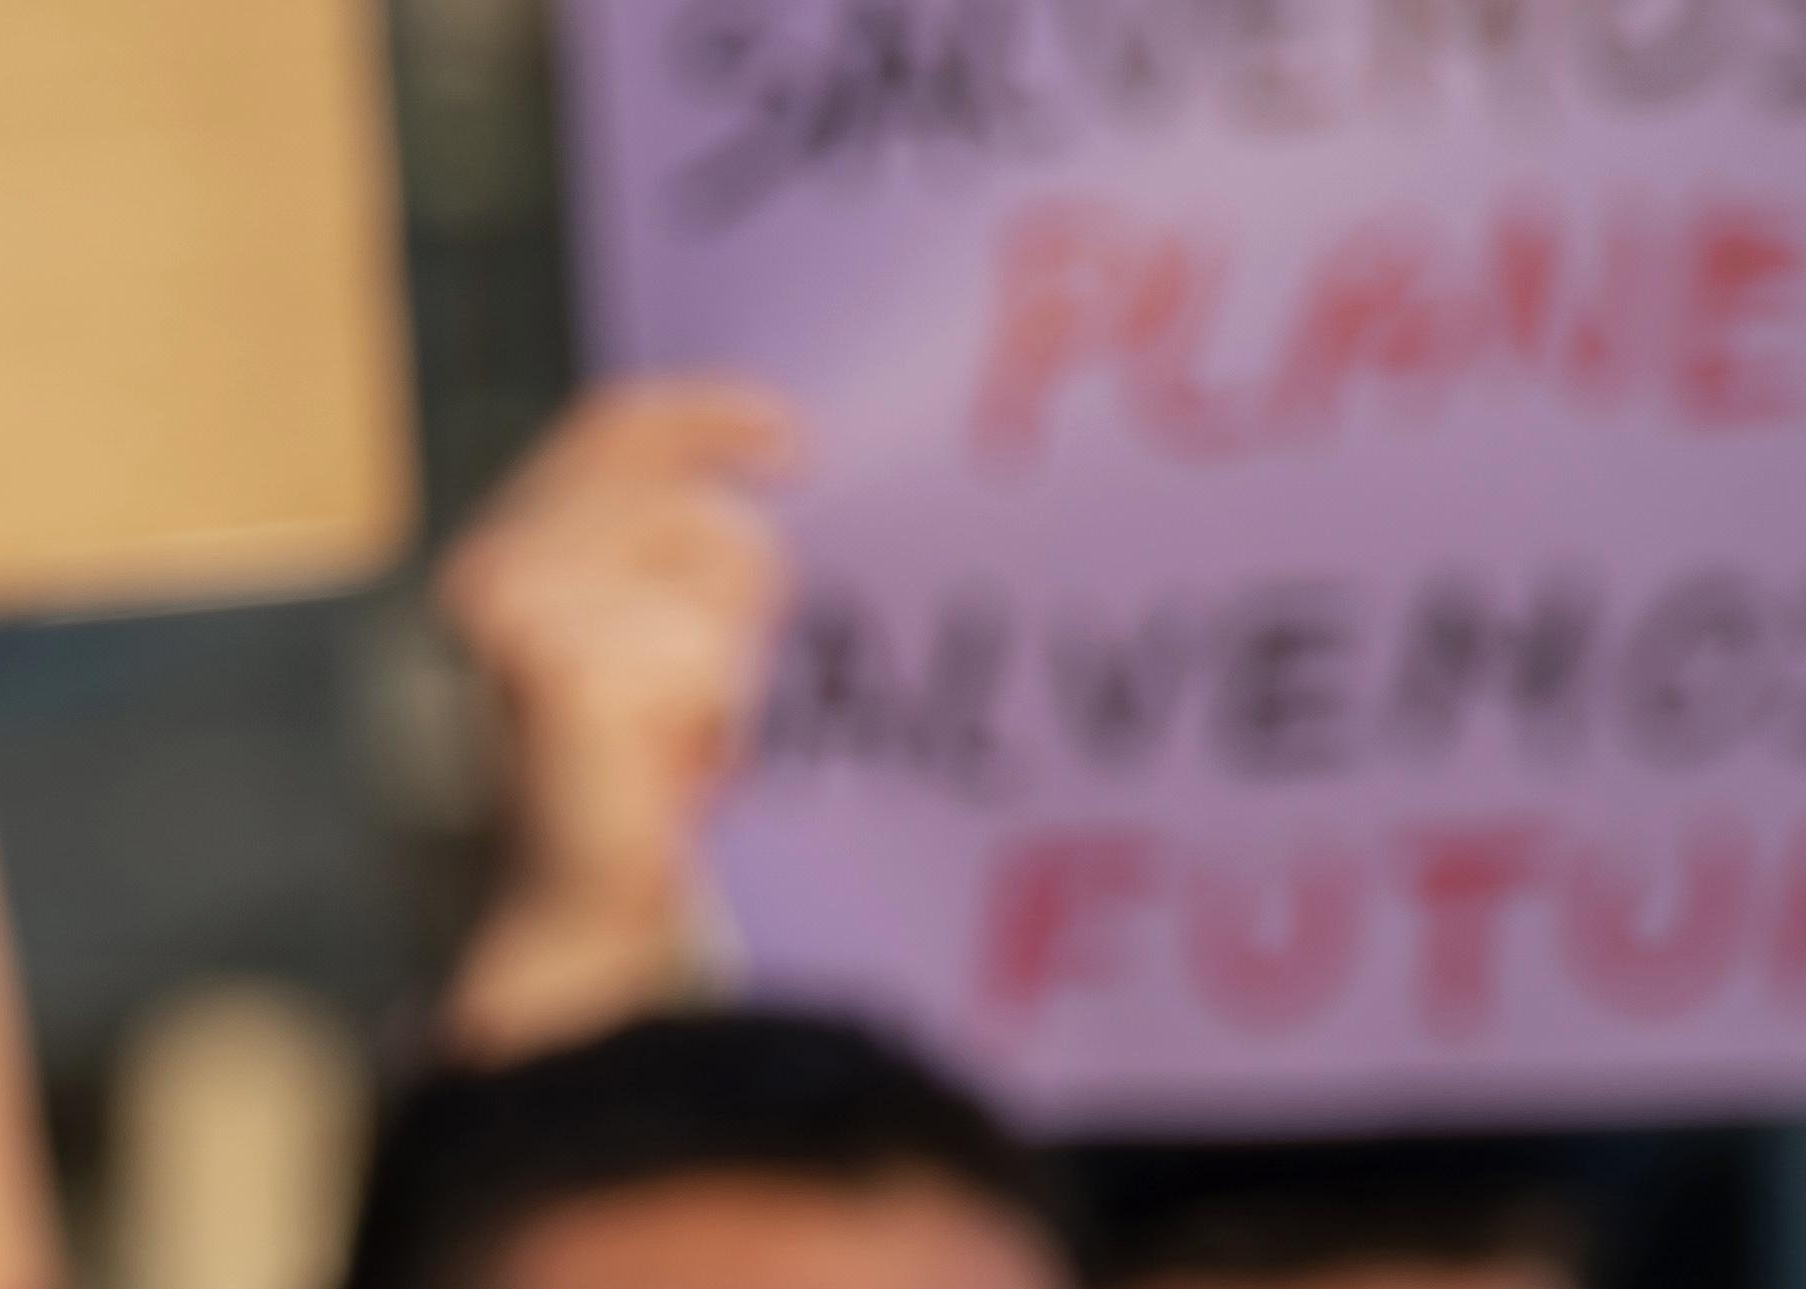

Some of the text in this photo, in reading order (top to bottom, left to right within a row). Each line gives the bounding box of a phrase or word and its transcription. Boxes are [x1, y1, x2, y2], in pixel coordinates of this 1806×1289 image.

[658, 0, 1806, 235] SALVEMO
[753, 570, 1806, 800] ALVEMO
[973, 815, 1806, 1045] FUTU
